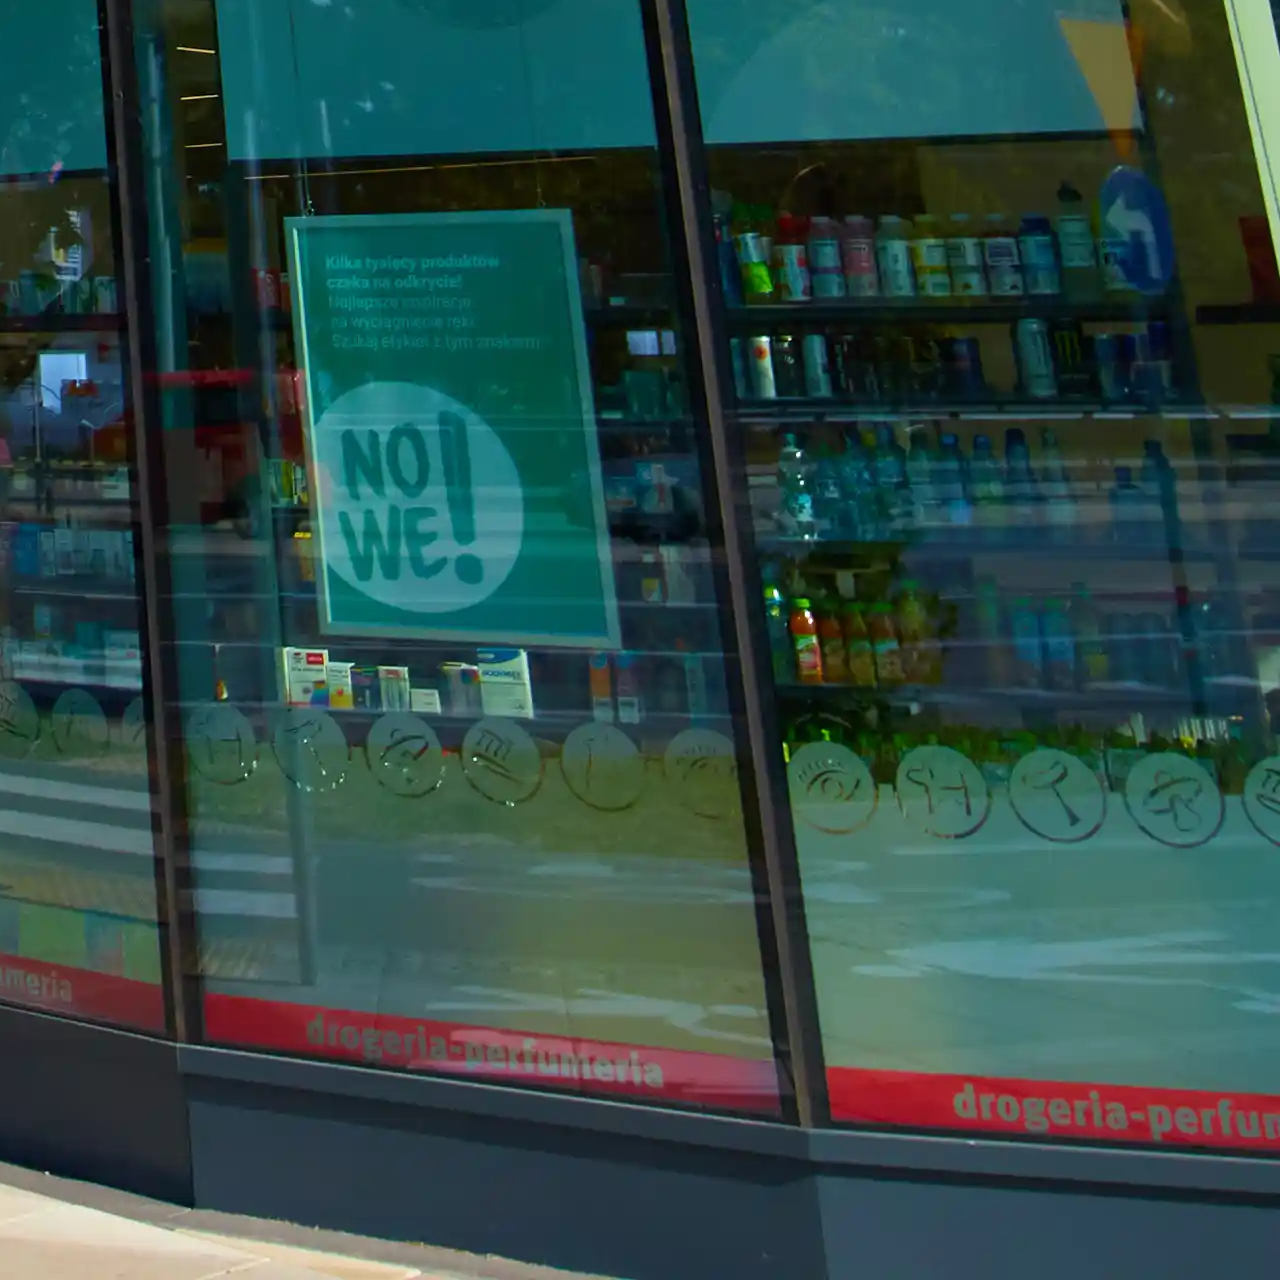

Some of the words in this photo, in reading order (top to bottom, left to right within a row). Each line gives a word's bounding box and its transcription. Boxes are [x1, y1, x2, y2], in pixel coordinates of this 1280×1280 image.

[325, 253, 362, 270] Kilka
[340, 420, 431, 501] NO
[306, 1012, 664, 1089] drogeria-perfumeria
